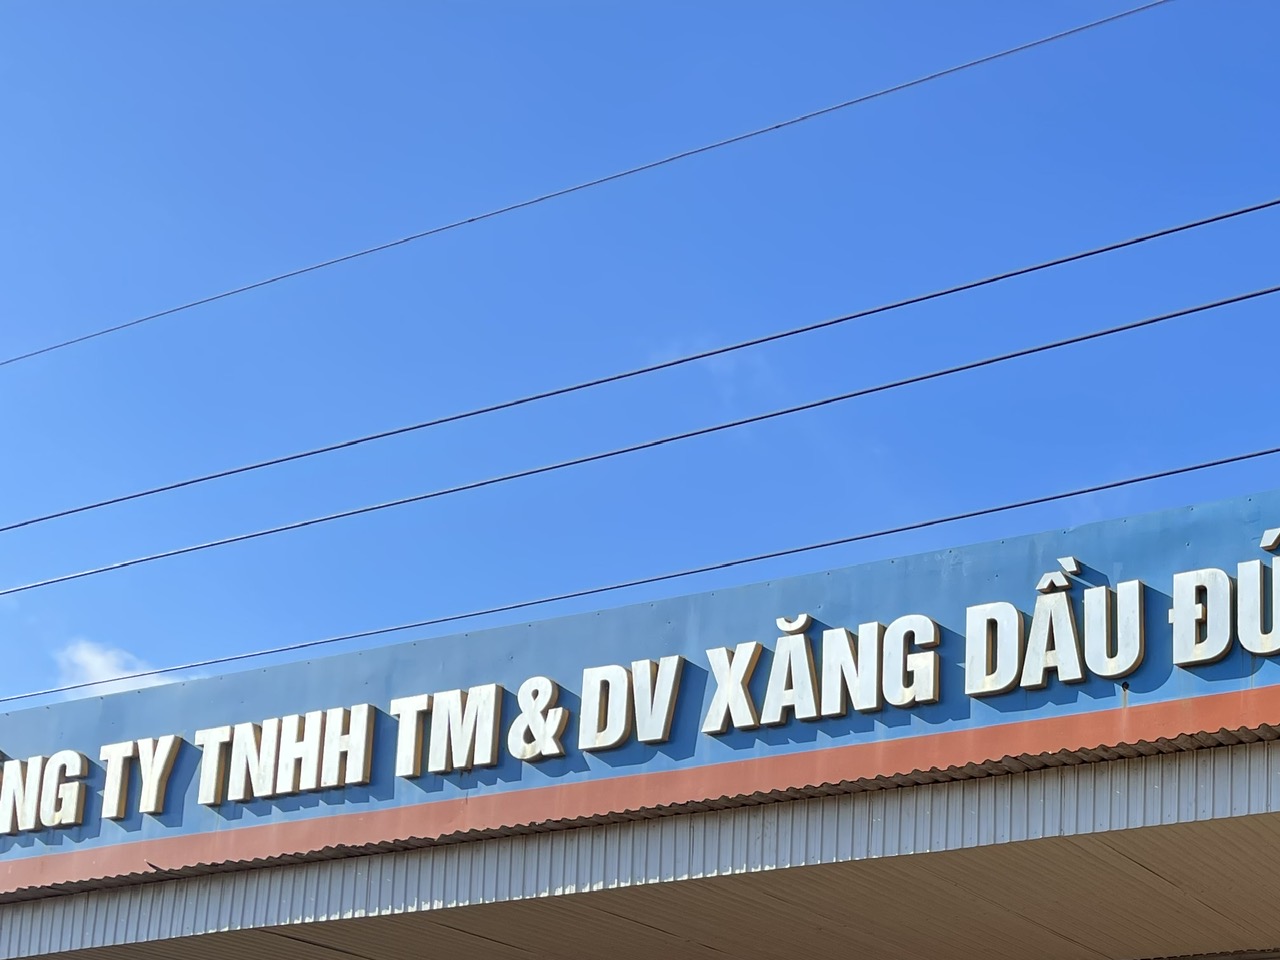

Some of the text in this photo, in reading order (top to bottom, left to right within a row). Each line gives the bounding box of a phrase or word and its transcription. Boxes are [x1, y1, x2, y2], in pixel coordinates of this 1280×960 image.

[100, 735, 181, 820] TY
[195, 704, 375, 805] TNHH
[390, 683, 503, 777] TM
[508, 676, 569, 762] &
[578, 655, 684, 752] DV
[702, 612, 940, 736] XĂNG
[965, 557, 1144, 698] DẦU
